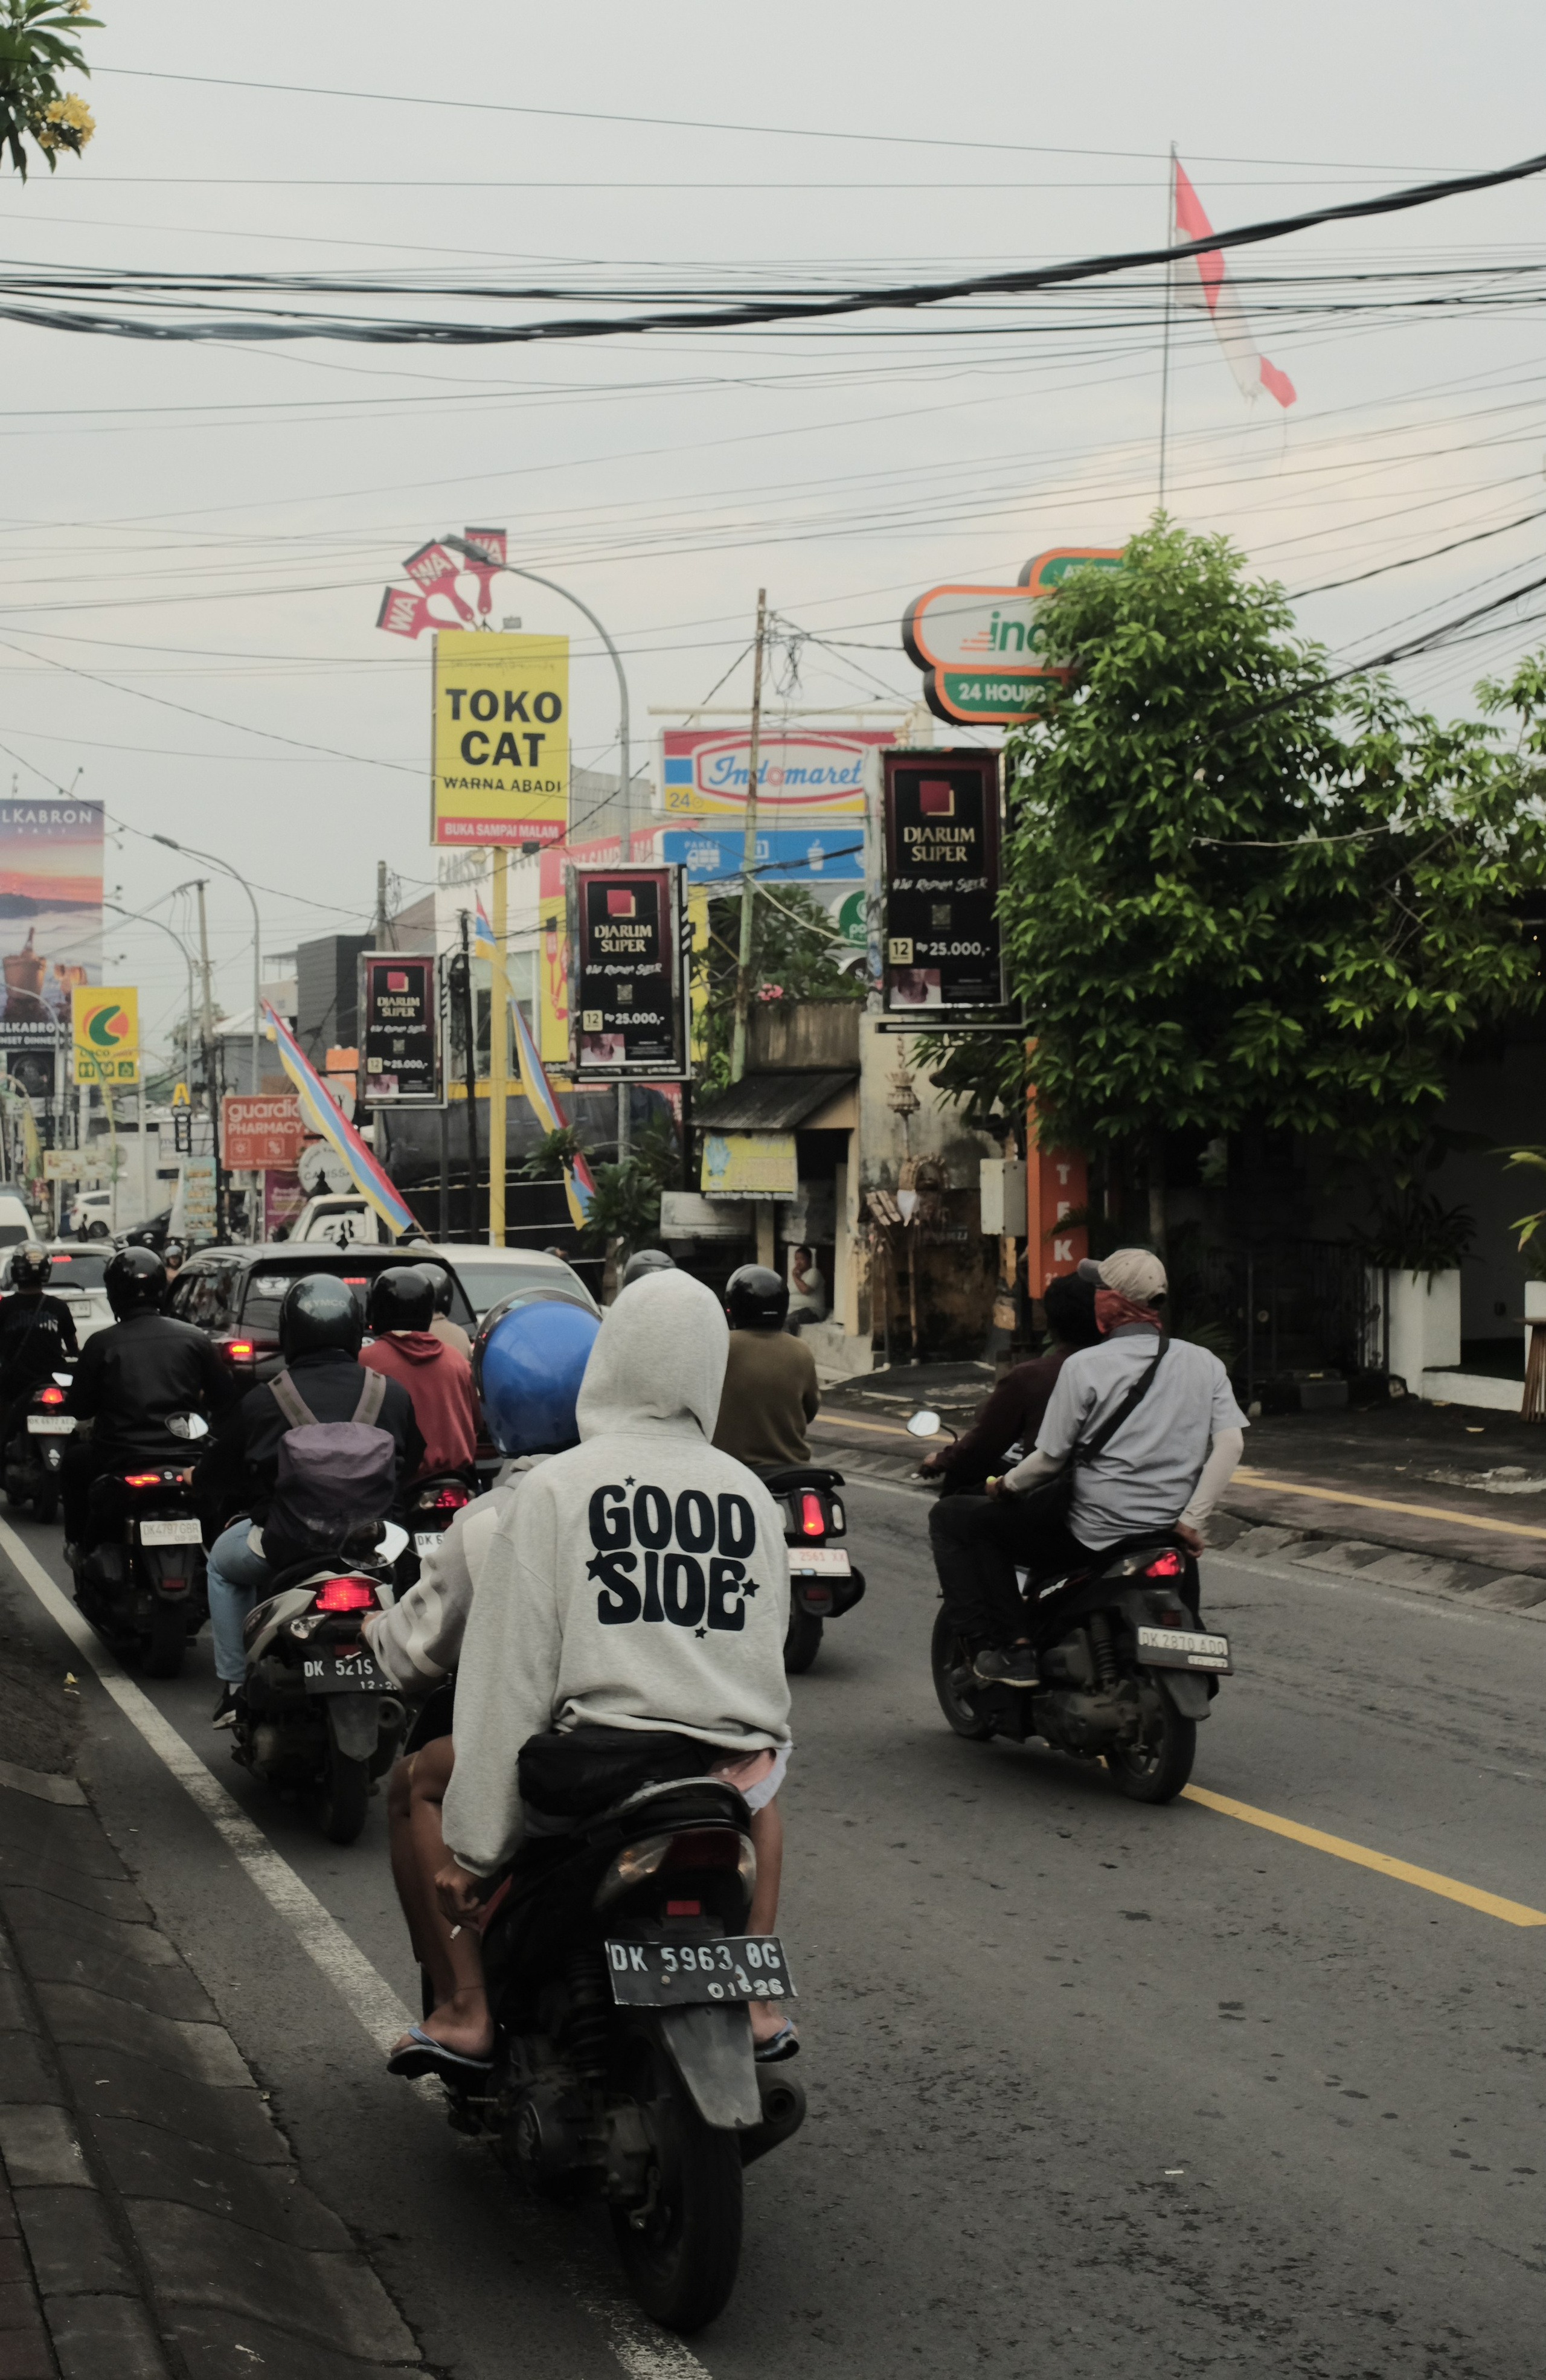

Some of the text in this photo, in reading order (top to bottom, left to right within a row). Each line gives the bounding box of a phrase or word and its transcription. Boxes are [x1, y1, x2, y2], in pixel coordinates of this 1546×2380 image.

[411, 551, 453, 586] WA
[387, 597, 419, 631] WA
[958, 682, 982, 701] 24
[445, 688, 563, 723] TOKO
[460, 730, 546, 768] CAT
[708, 755, 862, 786] Indomaret
[443, 777, 562, 794] WARNA ABADI
[670, 792, 690, 808] 24
[2, 808, 92, 824] LKABRON
[444, 821, 559, 839] BUKA SAMPAI MALAM
[903, 827, 975, 844] DJARUM
[911, 846, 968, 862] SUPER
[595, 925, 652, 938] DJARUM
[600, 939, 646, 952] SUPER
[893, 941, 909, 955] 12
[377, 997, 420, 1007] DJARUM
[382, 1007, 415, 1018] SUPER
[586, 1013, 599, 1024] 12
[228, 1122, 303, 1134] PHARMACY
[589, 1484, 755, 1559] GOOD
[417, 1536, 433, 1545] DK
[597, 1551, 746, 1632] SIDE
[304, 1660, 324, 1677] DK
[610, 1944, 649, 1971] DK
[660, 1945, 733, 1972] 5963
